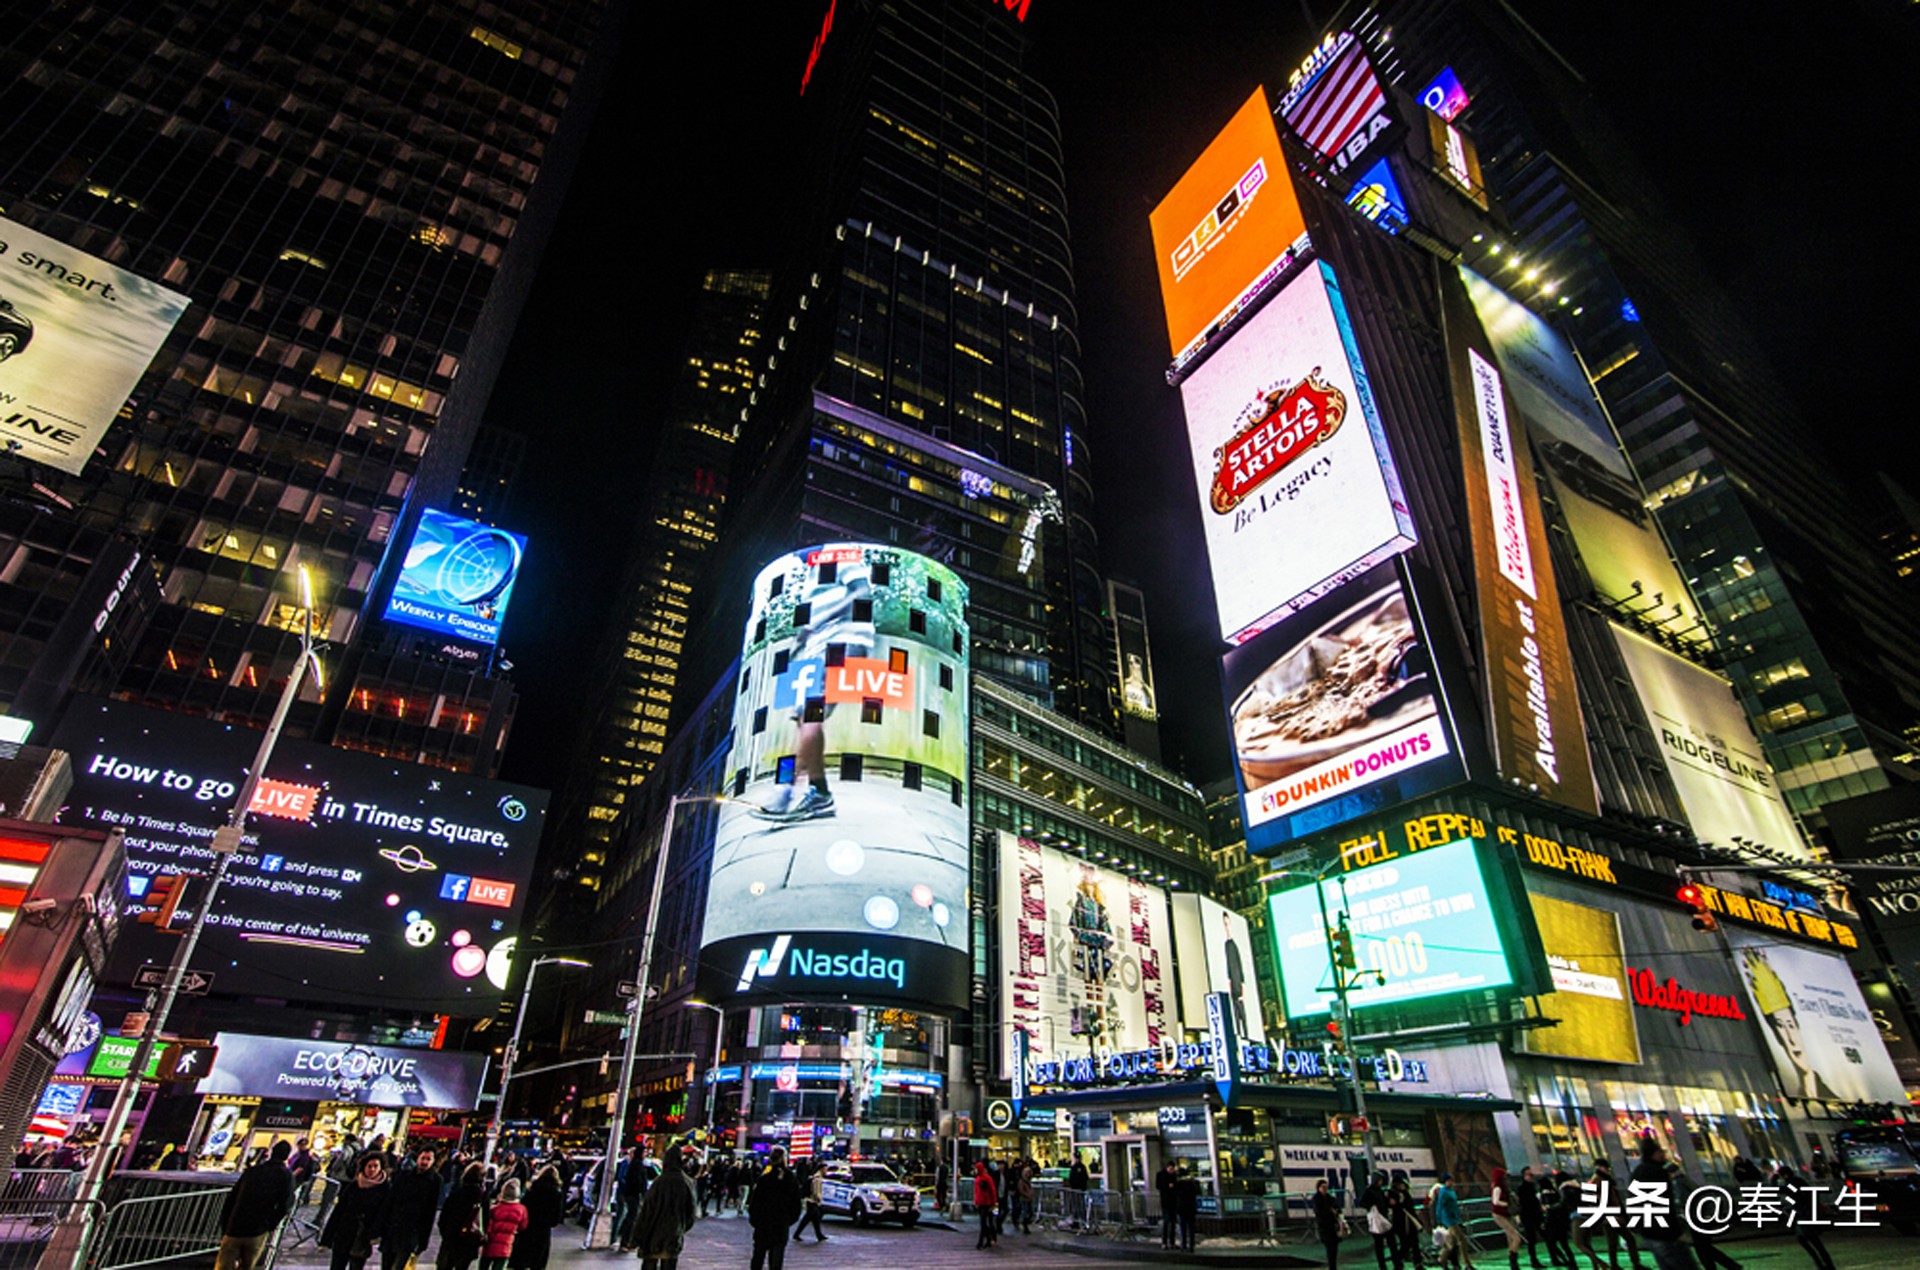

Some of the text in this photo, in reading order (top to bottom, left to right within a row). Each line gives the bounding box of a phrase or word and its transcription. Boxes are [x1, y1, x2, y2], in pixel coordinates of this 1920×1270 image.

[17, 250, 117, 302] smart.
[0, 413, 80, 446] INE
[1228, 396, 1314, 471] STELLA
[1231, 411, 1319, 490] ARTOIS
[1233, 454, 1334, 534] Be Legacy
[391, 599, 445, 622] WEEKLY
[838, 669, 903, 697] LIVE
[1515, 600, 1560, 784] Available at
[1276, 732, 1432, 808] DUNKIN' DONUTS
[1661, 727, 1770, 788] RIDGELINE
[88, 754, 510, 848] How to go LIVE in Times Square.
[100, 811, 118, 822] Be
[121, 814, 135, 825] in
[138, 816, 175, 832] Times
[147, 842, 181, 852] your
[245, 854, 259, 866] to
[283, 861, 308, 873] and
[306, 866, 339, 878] press
[1340, 831, 1399, 871] FULL
[1523, 832, 1618, 885] DODD-FRANK
[230, 875, 270, 887] you're
[270, 881, 305, 896] going
[306, 885, 320, 896] to
[473, 884, 508, 901] LIVE
[205, 913, 219, 924] to
[222, 915, 242, 927] the
[244, 919, 284, 932] center
[285, 922, 300, 934] of
[301, 924, 320, 936] the
[321, 928, 372, 944] universe.
[790, 948, 906, 988] Nasdaq
[1627, 966, 1747, 1026] Walgreens
[277, 1073, 326, 1087] Powered
[326, 1077, 341, 1090] by
[293, 1050, 417, 1077] ECO-DRIVE
[1057, 1051, 1096, 1084] YORK
[1100, 1046, 1158, 1080] POLICE
[1270, 1037, 1322, 1076] YORK
